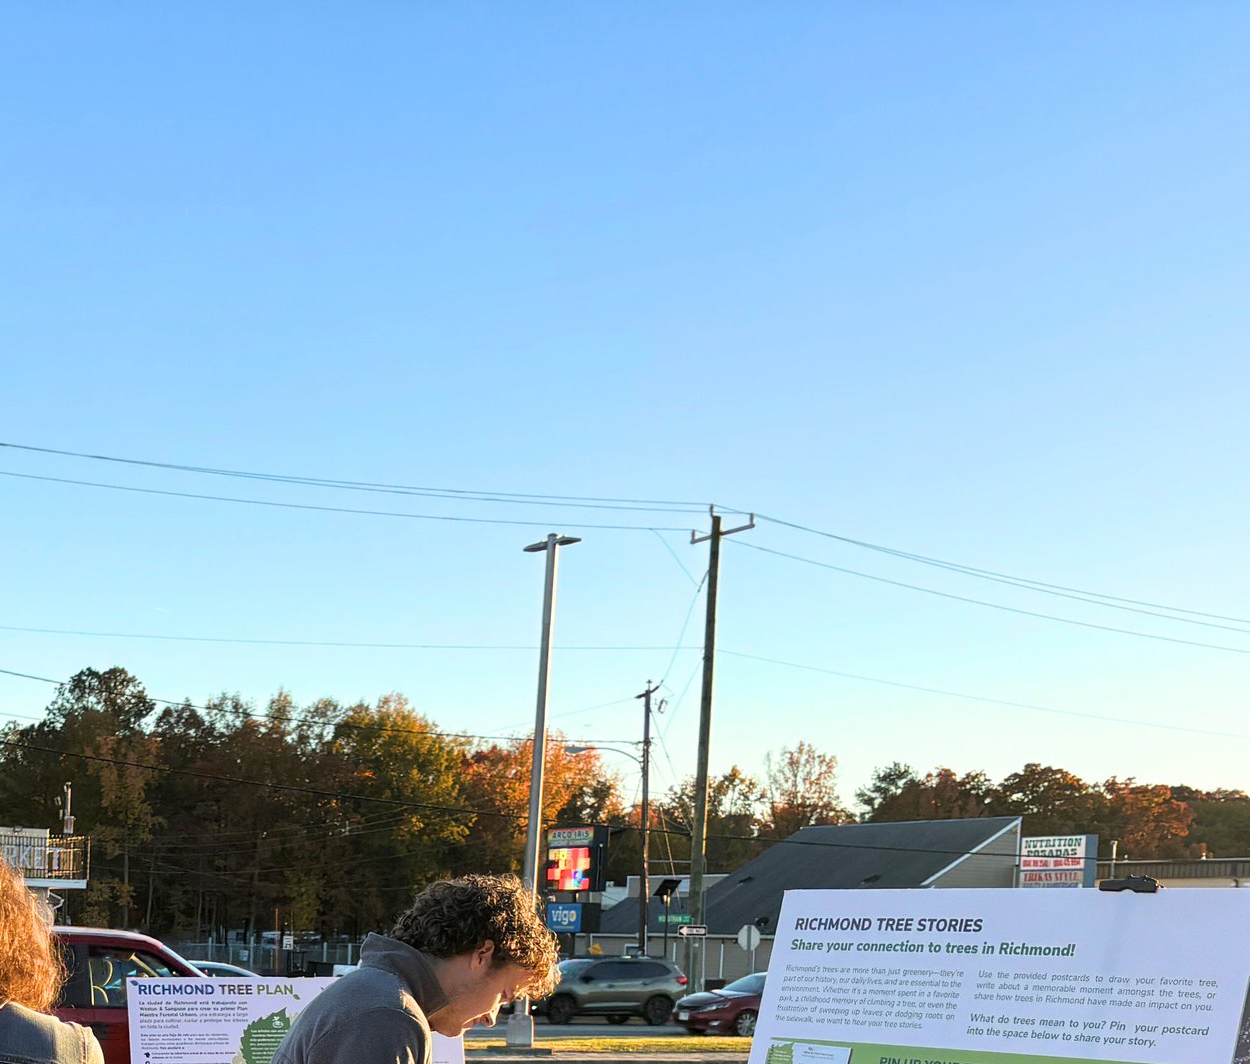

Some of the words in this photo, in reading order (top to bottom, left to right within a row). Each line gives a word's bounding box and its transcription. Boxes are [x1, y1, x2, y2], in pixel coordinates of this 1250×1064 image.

[1024, 838, 1082, 849] NUTRITION
[1027, 848, 1078, 857] POSADAS
[3, 845, 63, 870] RKET
[552, 906, 576, 925] vigo
[795, 918, 872, 931] RICHMOND
[877, 918, 913, 932] TREE
[916, 918, 983, 933] STORIES
[791, 939, 824, 951] Share
[827, 941, 854, 953] your
[856, 940, 926, 953] connection
[928, 942, 941, 953] to
[945, 943, 978, 954] trees
[982, 942, 995, 955] in
[998, 942, 1076, 957] Richmond!
[786, 964, 821, 973] Richmond's
[871, 967, 886, 975] than
[886, 968, 901, 976] just
[978, 970, 993, 979] Use
[997, 971, 1010, 979] the
[1013, 972, 1047, 982] provided
[1051, 974, 1090, 983] postcards
[1095, 975, 1103, 983] to
[1108, 975, 1130, 984] draw
[1135, 977, 1155, 986] your
[1159, 977, 1193, 987] favorite
[1199, 978, 1219, 989] tree,
[138, 984, 215, 995] RICHMOND
[219, 984, 253, 995] TREE
[257, 984, 294, 995] PLAN
[976, 981, 995, 990] write
[999, 981, 1020, 991] about
[1032, 983, 1076, 993] memorable
[1080, 986, 1114, 995] moment
[1117, 987, 1155, 997] amongst
[1159, 988, 1173, 998] the
[1178, 989, 1202, 999] trees,
[1206, 991, 1216, 999] or
[974, 991, 994, 1001] share
[996, 992, 1013, 1002] how
[1014, 994, 1034, 1003] trees
[1035, 994, 1043, 1003] in
[1045, 995, 1085, 1005] Richmond
[1087, 997, 1108, 1007] have
[1109, 998, 1132, 1008] made
[1135, 1000, 1146, 1008] an
[1148, 1000, 1178, 1011] impact
[1181, 1002, 1192, 1010] on
[1194, 1003, 1213, 1013] you.
[970, 1013, 995, 1024] What
[997, 1015, 1010, 1024] do
[1013, 1016, 1036, 1026] trees
[1039, 1018, 1066, 1028] mean
[1069, 1019, 1079, 1029] to
[1083, 1020, 1106, 1031] you?
[1109, 1021, 1126, 1031] Pin
[1135, 1023, 1158, 1034] your
[1162, 1025, 1210, 1037] postcard
[967, 1026, 984, 1036] into
[986, 1027, 1001, 1037] the
[1002, 1030, 1028, 1040] space
[1031, 1029, 1059, 1041] below
[1062, 1032, 1072, 1042] to
[1074, 1033, 1101, 1044] share
[1103, 1035, 1127, 1046] your
[1128, 1036, 1157, 1048] story.
